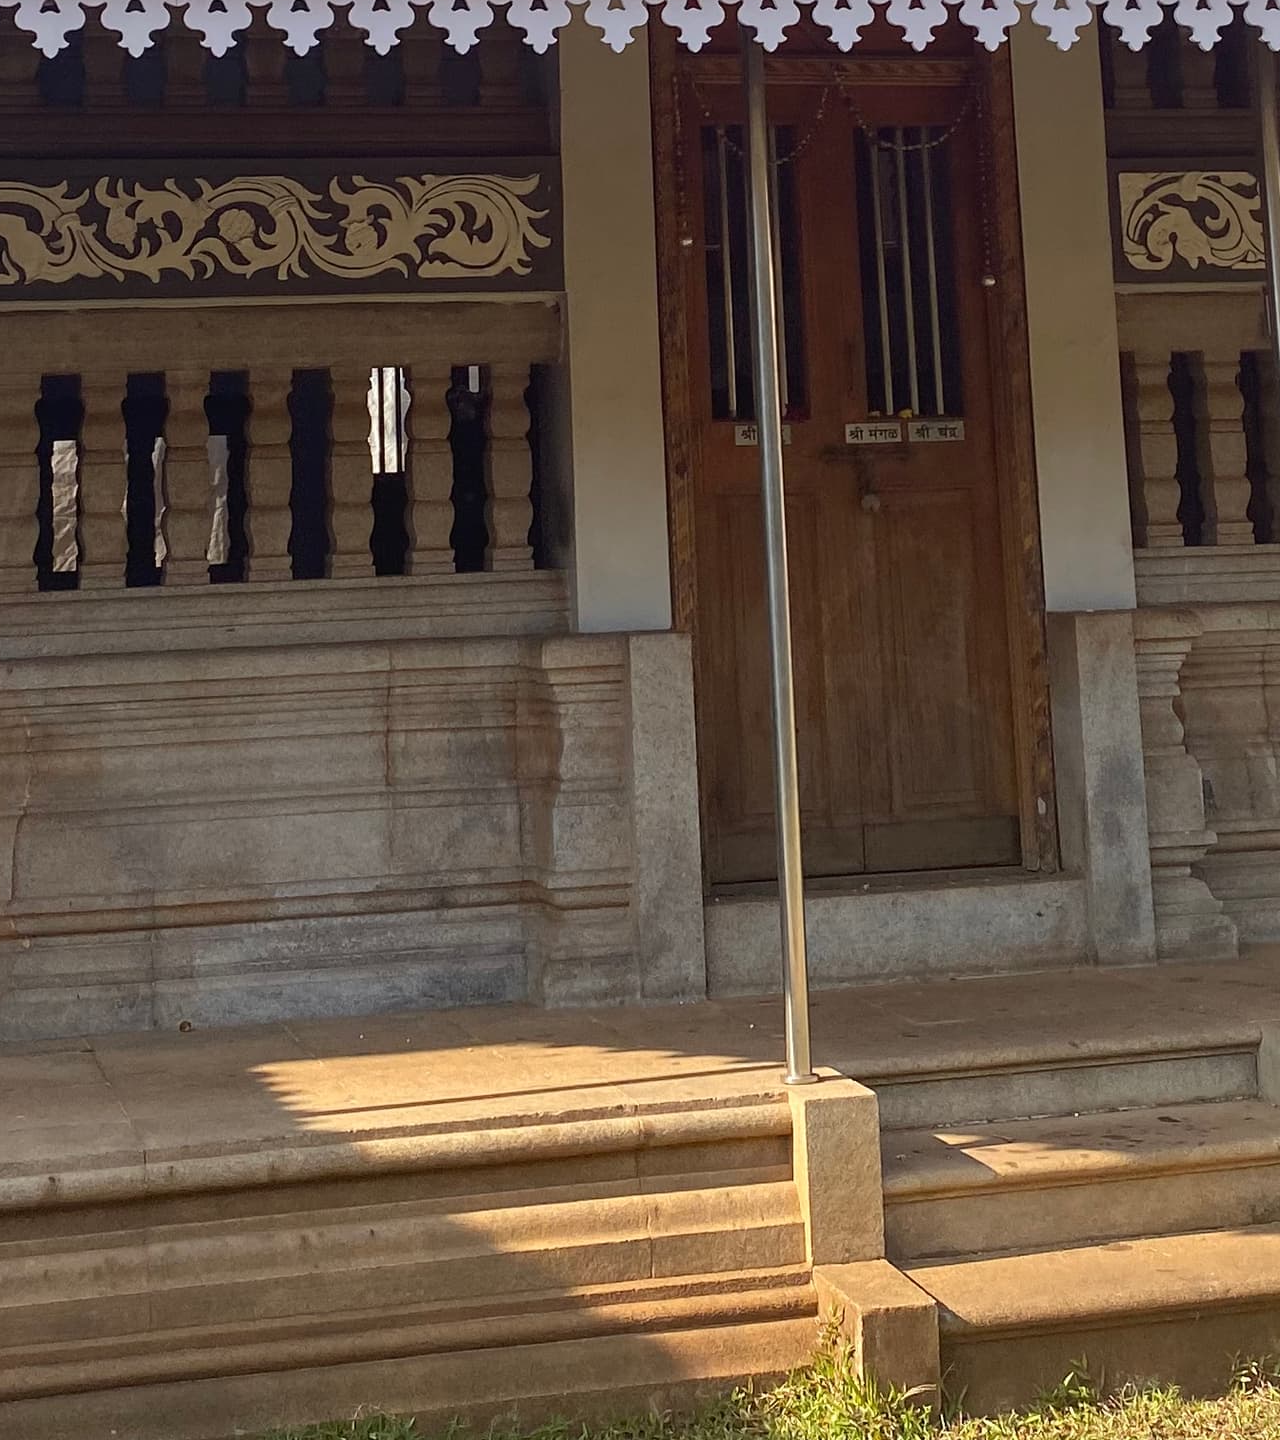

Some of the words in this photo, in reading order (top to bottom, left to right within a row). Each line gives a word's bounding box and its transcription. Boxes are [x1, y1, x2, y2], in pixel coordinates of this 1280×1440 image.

[849, 426, 863, 441] श्री
[868, 425, 898, 440] मंगळ
[915, 423, 930, 440] श्री
